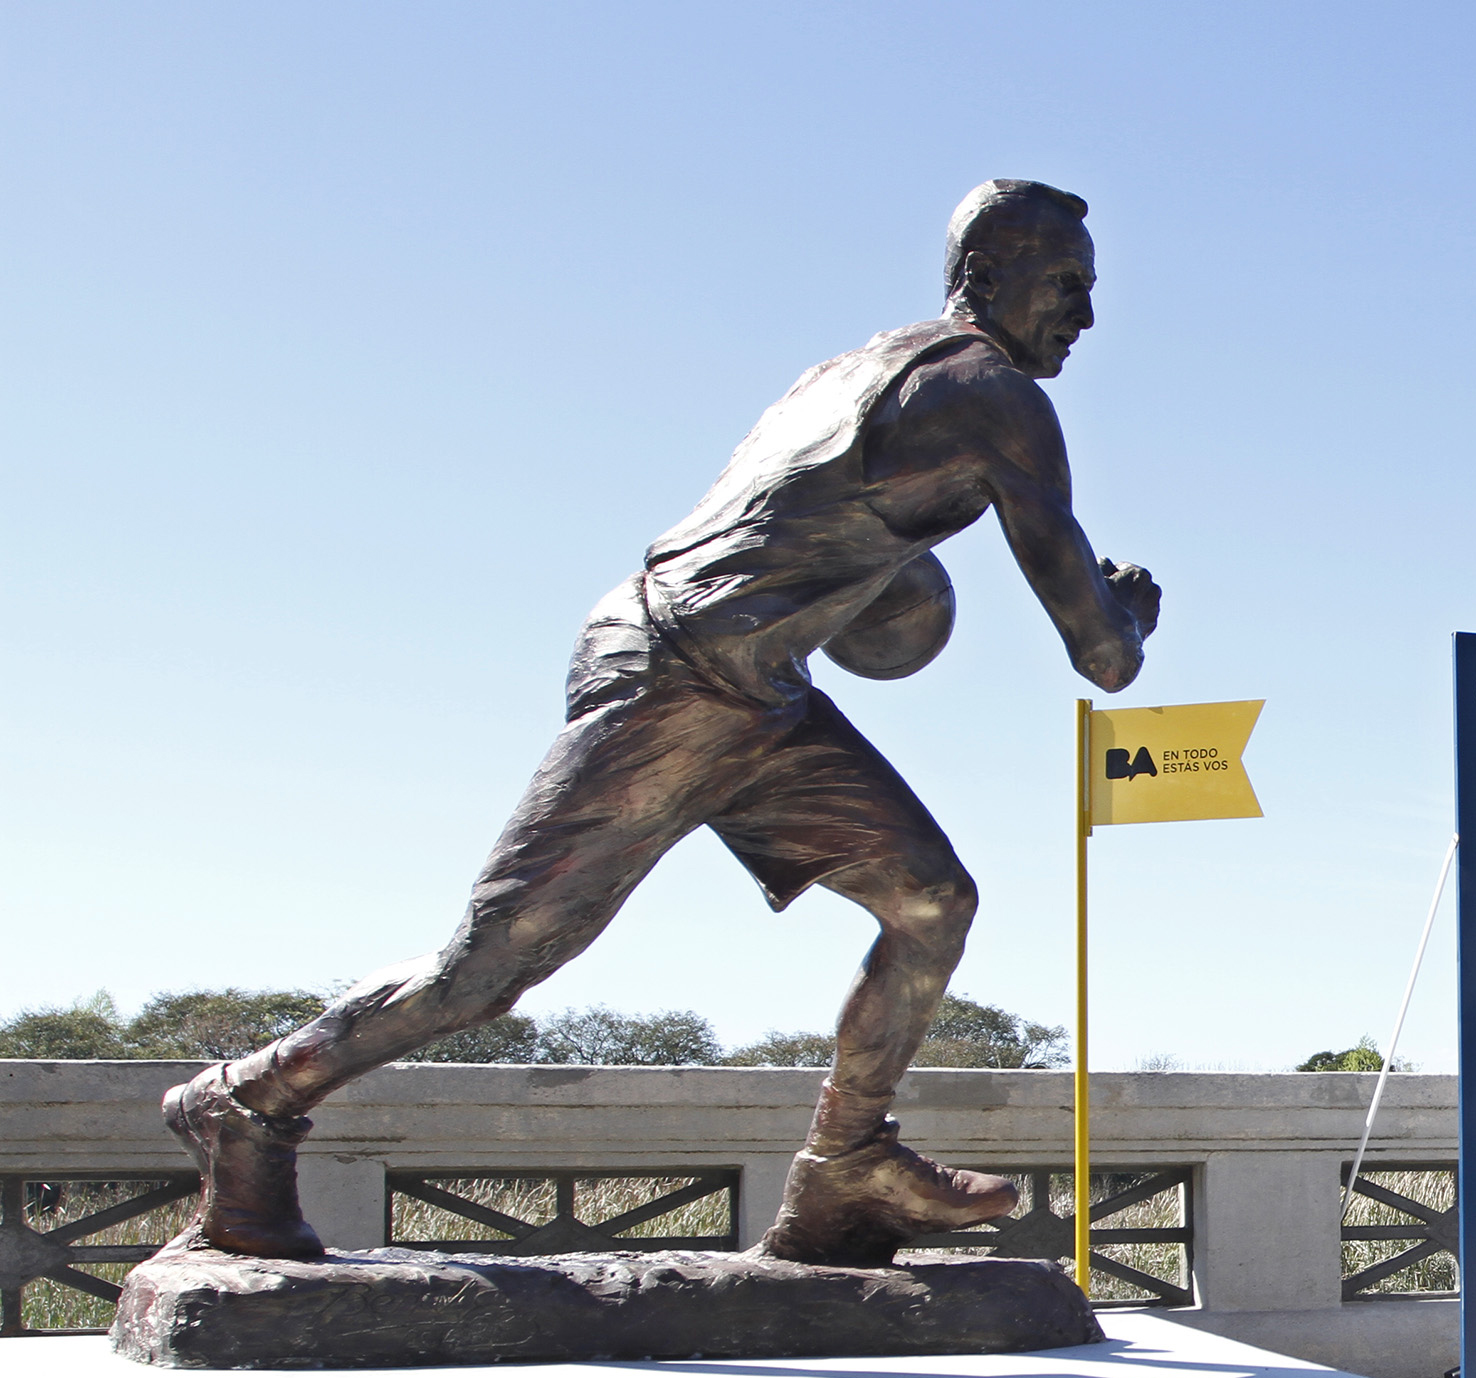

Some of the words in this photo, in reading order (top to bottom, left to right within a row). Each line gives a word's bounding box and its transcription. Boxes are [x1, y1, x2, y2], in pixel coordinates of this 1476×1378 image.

[1163, 750, 1179, 761] EN
[1183, 747, 1218, 760] TODO
[1105, 746, 1158, 781] BA
[1163, 760, 1200, 774] ESTÁS
[1204, 760, 1228, 771] VOS
